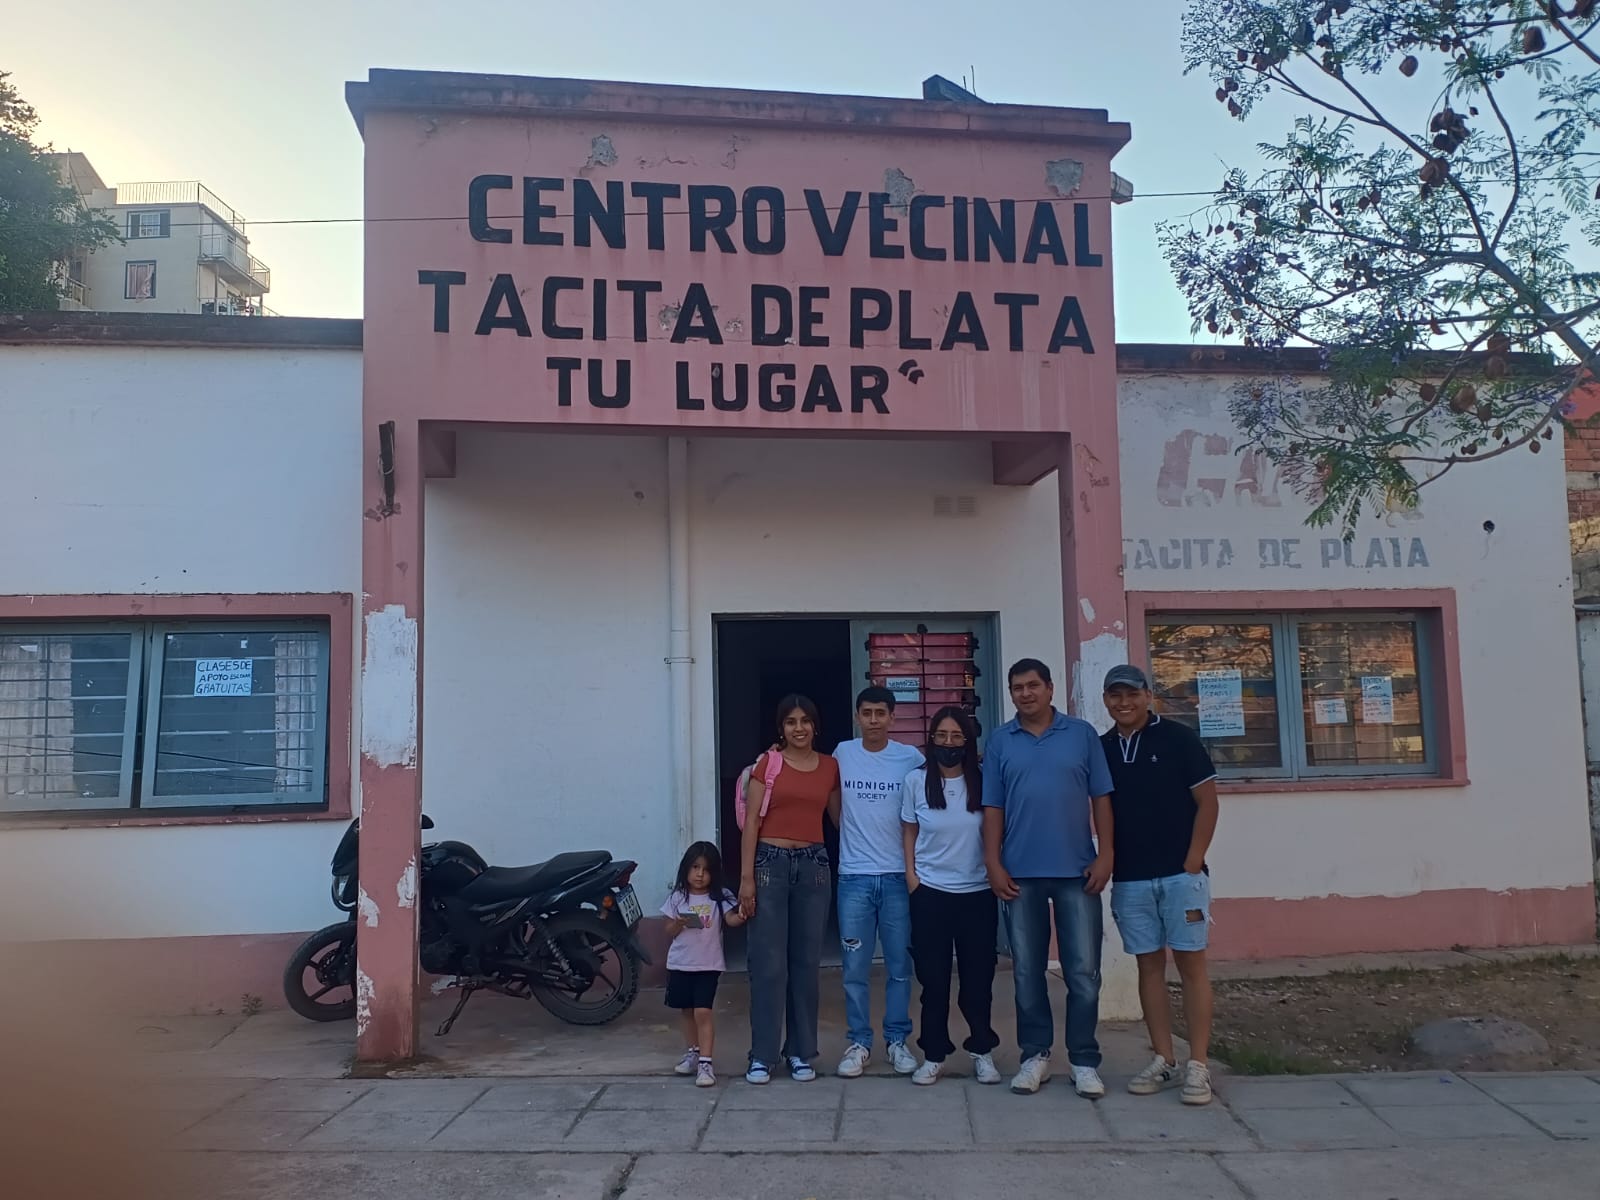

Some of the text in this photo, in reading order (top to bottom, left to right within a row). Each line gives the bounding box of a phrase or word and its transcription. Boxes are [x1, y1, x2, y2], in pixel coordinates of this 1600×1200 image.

[469, 174, 1103, 267] CENTRO VECINAL
[418, 270, 1095, 355] TACITA DE PLATA
[546, 356, 632, 409] TU
[1121, 537, 1431, 570] TACITA DE PLATA
[197, 660, 251, 672] CLASES DE
[200, 673, 229, 683] APOYO
[196, 682, 250, 694] GRATUITAS
[844, 780, 902, 792] MIDNIGHT
[857, 792, 888, 800] SOCIETY
